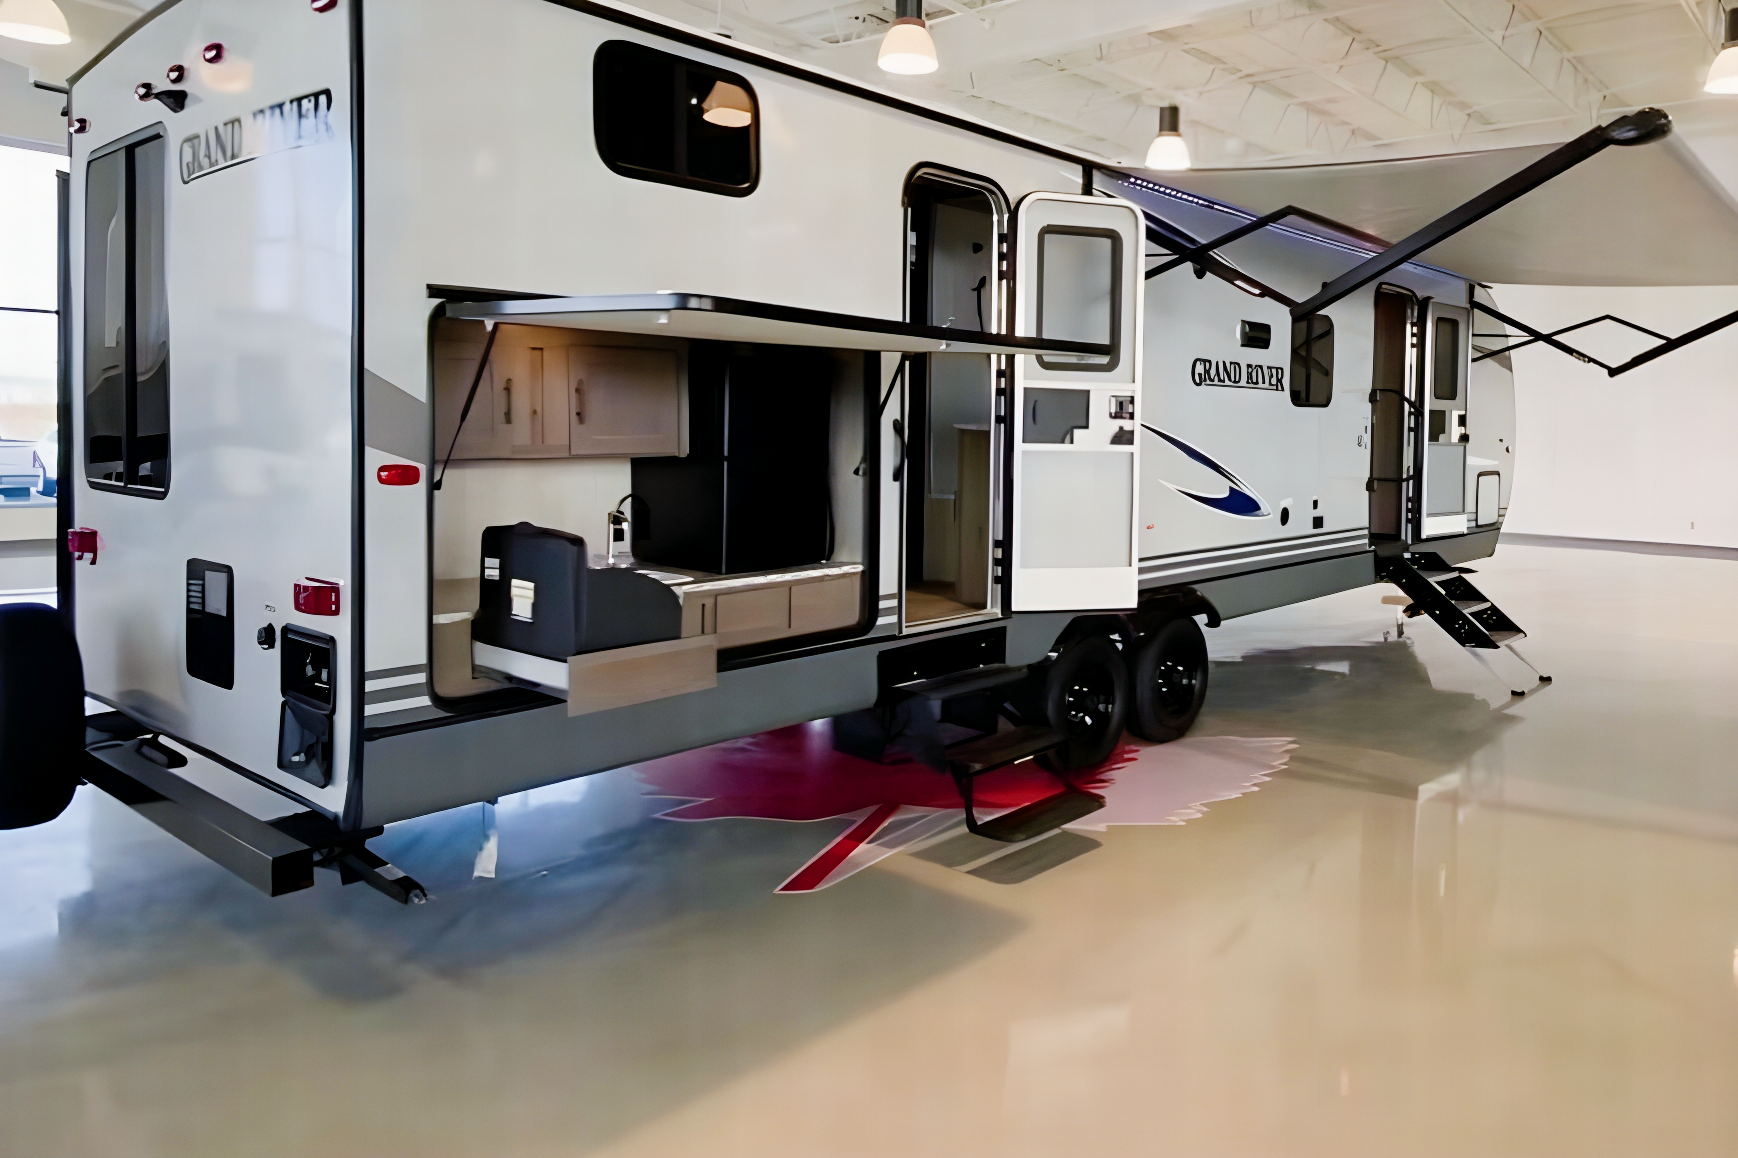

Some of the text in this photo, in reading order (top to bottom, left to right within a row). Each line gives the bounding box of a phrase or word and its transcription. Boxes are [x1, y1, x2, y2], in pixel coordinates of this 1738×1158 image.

[180, 88, 334, 184] GRAND VER
[1191, 357, 1285, 392] GRAND RIVER
